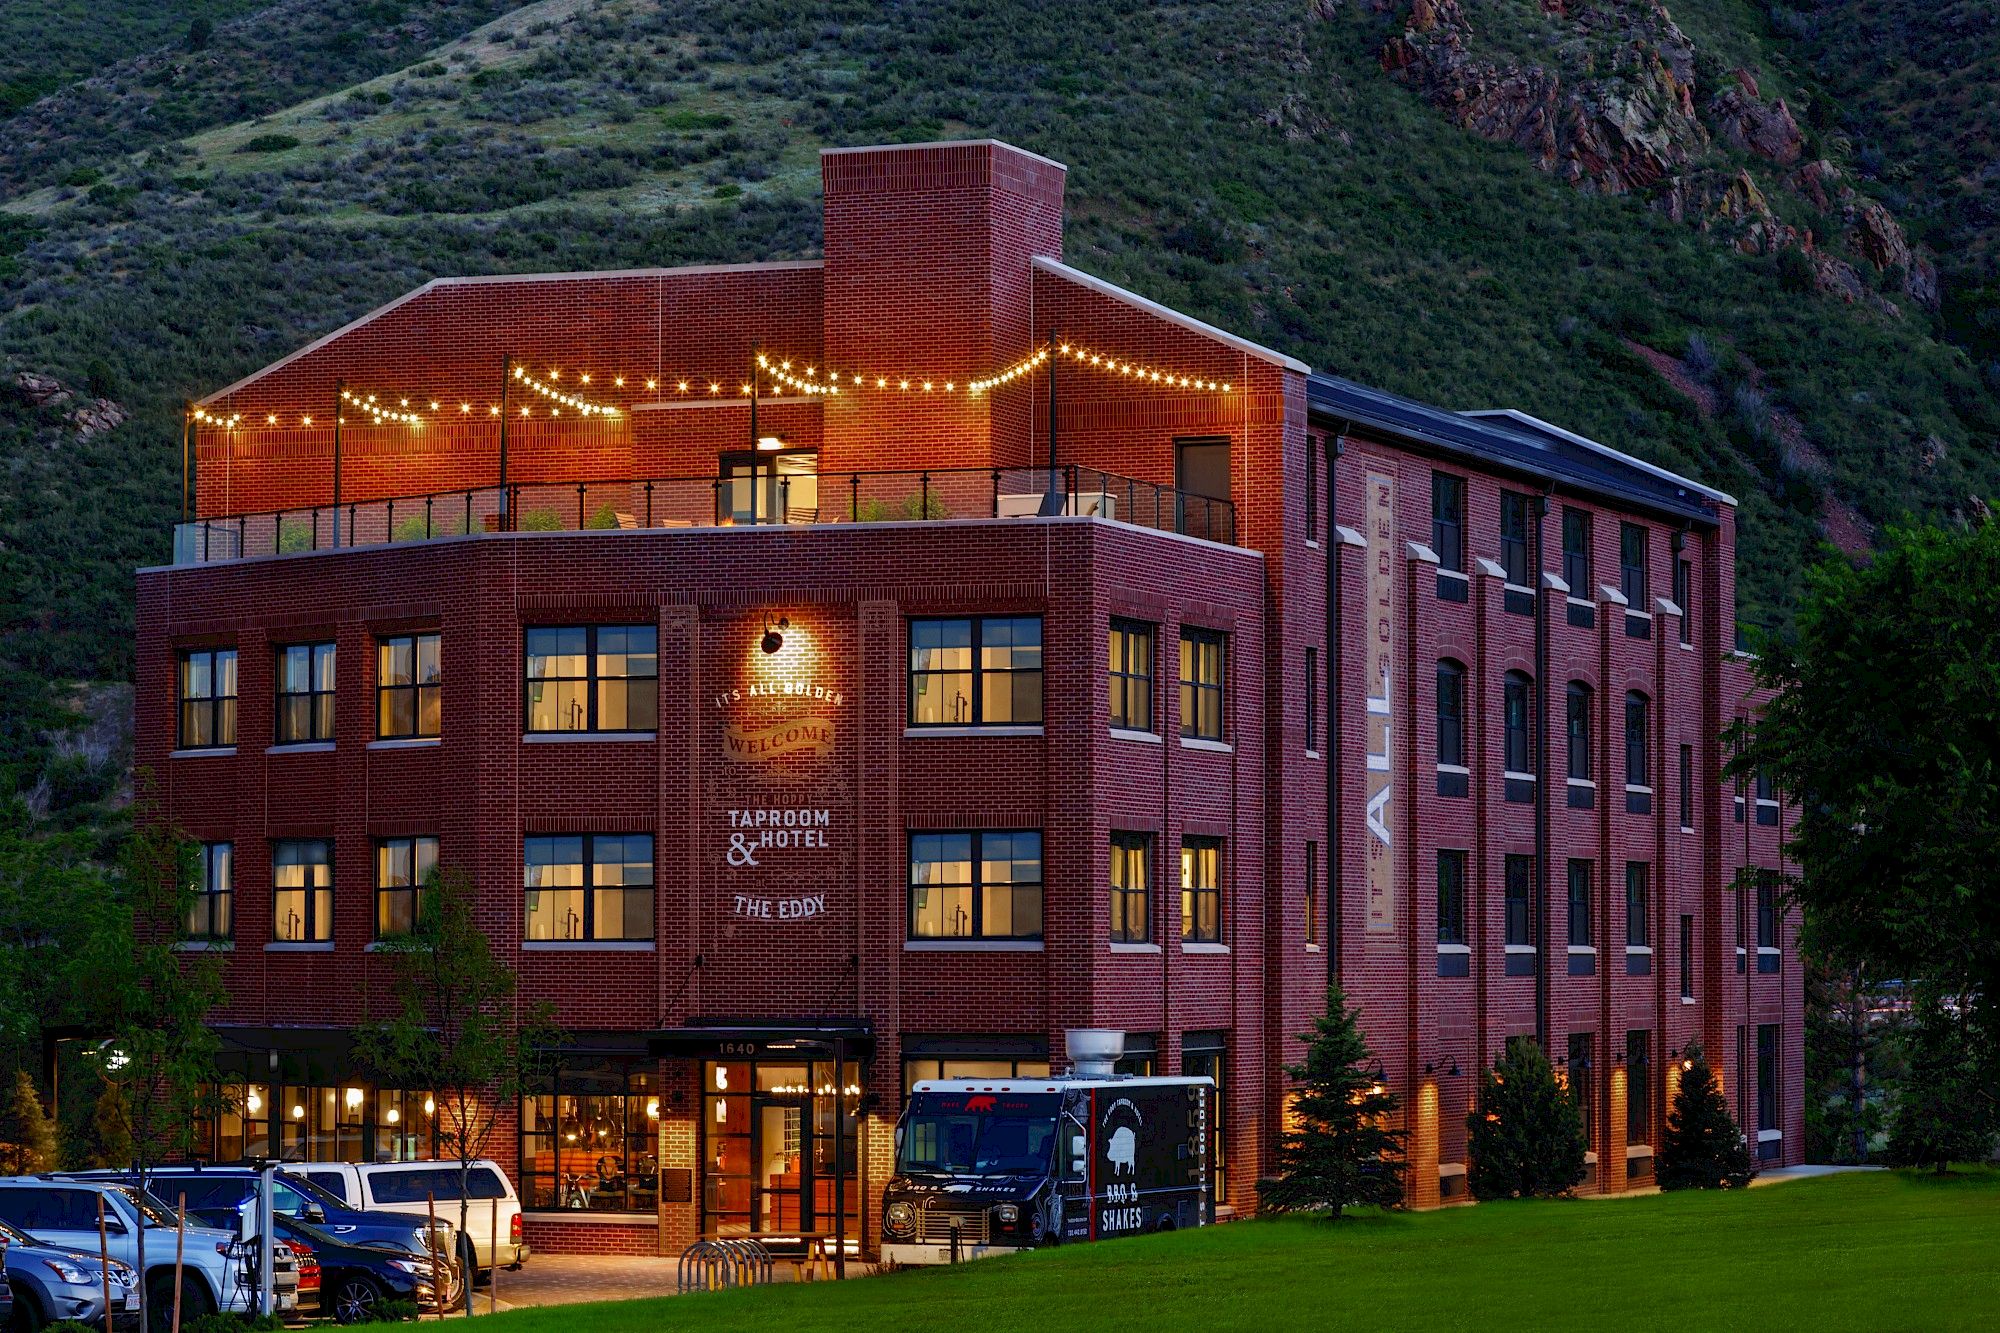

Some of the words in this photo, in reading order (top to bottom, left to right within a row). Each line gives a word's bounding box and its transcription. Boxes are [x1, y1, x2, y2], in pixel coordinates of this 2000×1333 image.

[1378, 484, 1390, 678] GOLDEN
[715, 689, 741, 708] IT'S
[749, 682, 776, 697] ALL
[727, 726, 833, 754] WELCOME
[1367, 668, 1390, 847] ALL
[745, 794, 768, 805] THE
[727, 809, 830, 828] TAPROOM
[726, 832, 760, 867] &
[761, 829, 830, 848] HOTEL
[734, 895, 772, 919] THE
[778, 893, 826, 919] EDDY
[719, 1043, 755, 1055] 1640
[1187, 1084, 1200, 1183] 1859
[1106, 1184, 1127, 1204] BBQ
[1130, 1182, 1139, 1202] &
[1102, 1206, 1142, 1232] SHAKES
